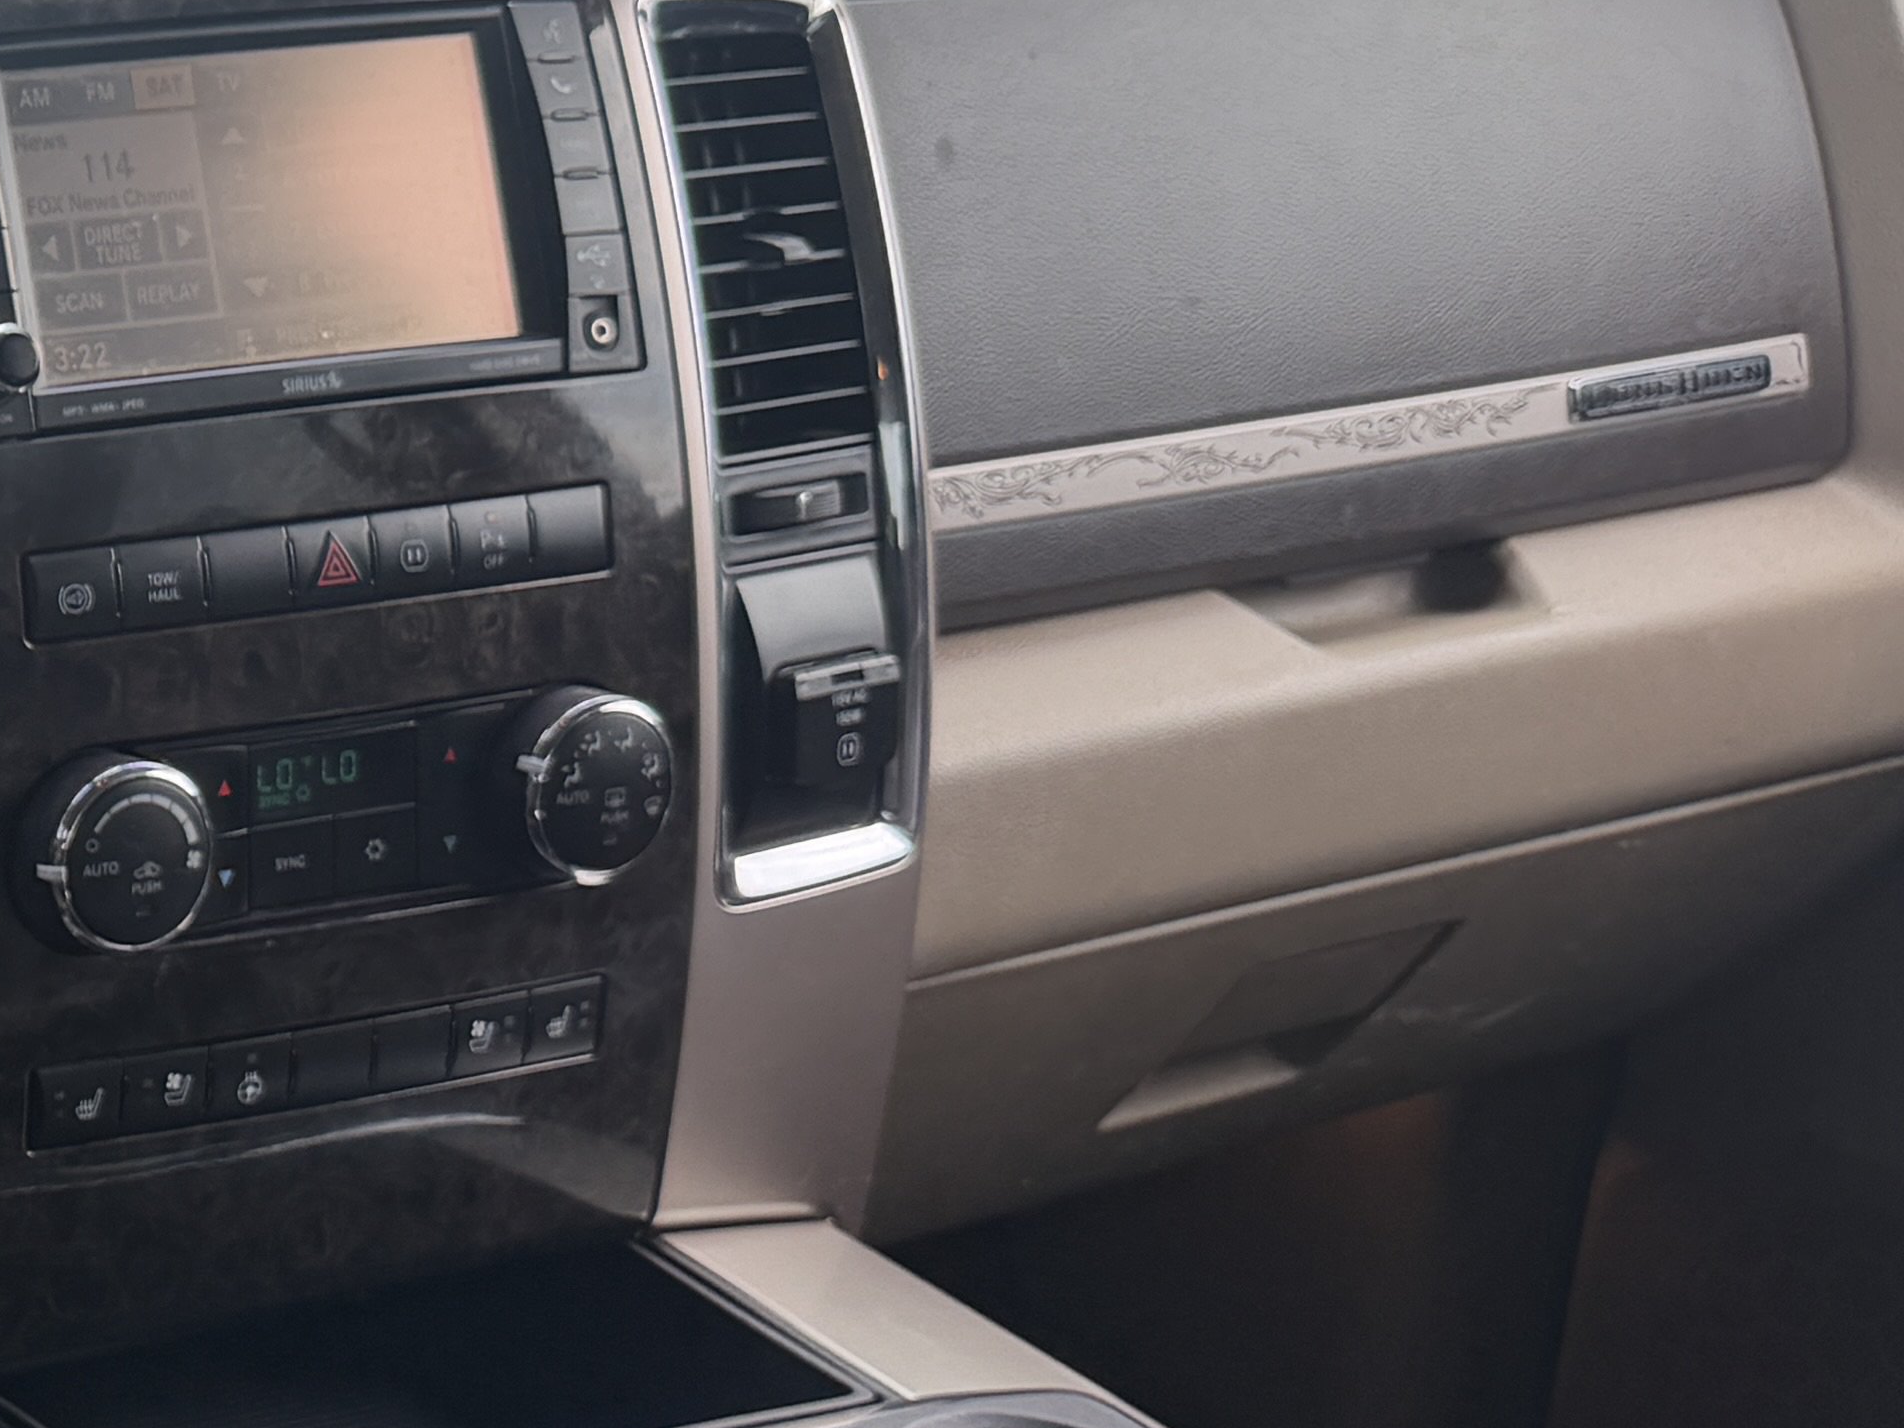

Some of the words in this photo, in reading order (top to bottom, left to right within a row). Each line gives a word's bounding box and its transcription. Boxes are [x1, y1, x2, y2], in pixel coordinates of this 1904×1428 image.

[18, 86, 51, 109] AM
[85, 81, 116, 103] FM
[145, 73, 184, 97] SAT
[14, 132, 69, 152] News
[80, 147, 136, 183] 114
[25, 191, 65, 218] FOX
[68, 191, 121, 212] News
[122, 182, 195, 207] Channel
[83, 221, 143, 247] DIRECT
[94, 243, 143, 266] TUNE
[54, 290, 105, 314] SCAN
[137, 282, 201, 306] REPLAY
[53, 341, 112, 372] 3:22
[281, 374, 328, 395] SIRIUS
[257, 757, 293, 793] LO
[321, 749, 357, 785] LO
[555, 789, 591, 805] AUTO
[83, 860, 120, 877] AUTO
[275, 854, 306, 871] SYNC
[131, 880, 163, 896] PUSH
